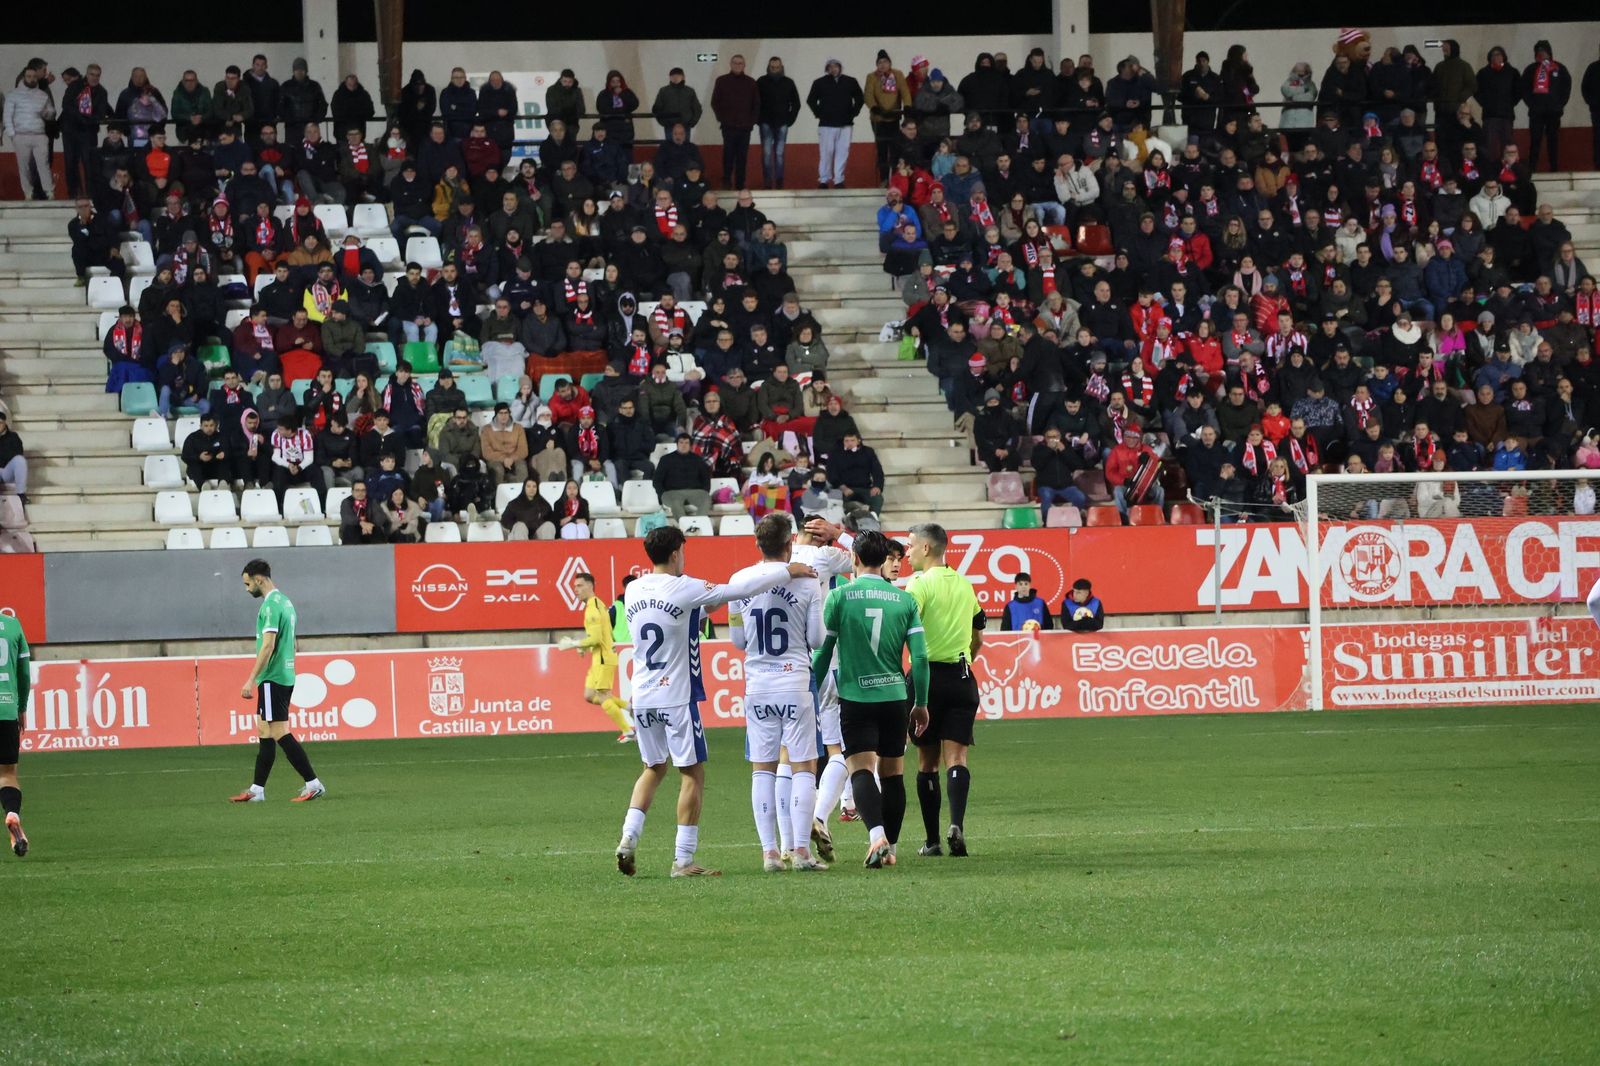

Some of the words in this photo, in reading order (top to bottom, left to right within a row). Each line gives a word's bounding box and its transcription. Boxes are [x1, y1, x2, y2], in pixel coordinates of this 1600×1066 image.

[1196, 523, 1501, 606] ZAMORA
[1505, 520, 1600, 599] CF
[411, 583, 468, 593] NISSAN
[484, 594, 541, 602] DACIA
[626, 600, 647, 623] DAVID
[650, 599, 684, 620] RGUEZ
[640, 622, 667, 671] 2
[749, 607, 789, 656] 16
[865, 608, 883, 656] 7
[1374, 631, 1467, 650] bodegas
[1535, 627, 1569, 643] del
[1071, 636, 1257, 672] Escuela
[1333, 635, 1594, 682] Sumiller
[25, 672, 150, 731] inión
[470, 699, 523, 714] Junta
[528, 697, 552, 711] de
[978, 677, 1062, 720] gura
[1077, 675, 1260, 712] infantil
[1337, 684, 1596, 702] www.bodegasdelsumiller.com
[310, 730, 337, 741] león
[419, 718, 485, 734] Castilla
[490, 721, 501, 735] y
[508, 716, 553, 731] León
[37, 733, 119, 749] Zamora
